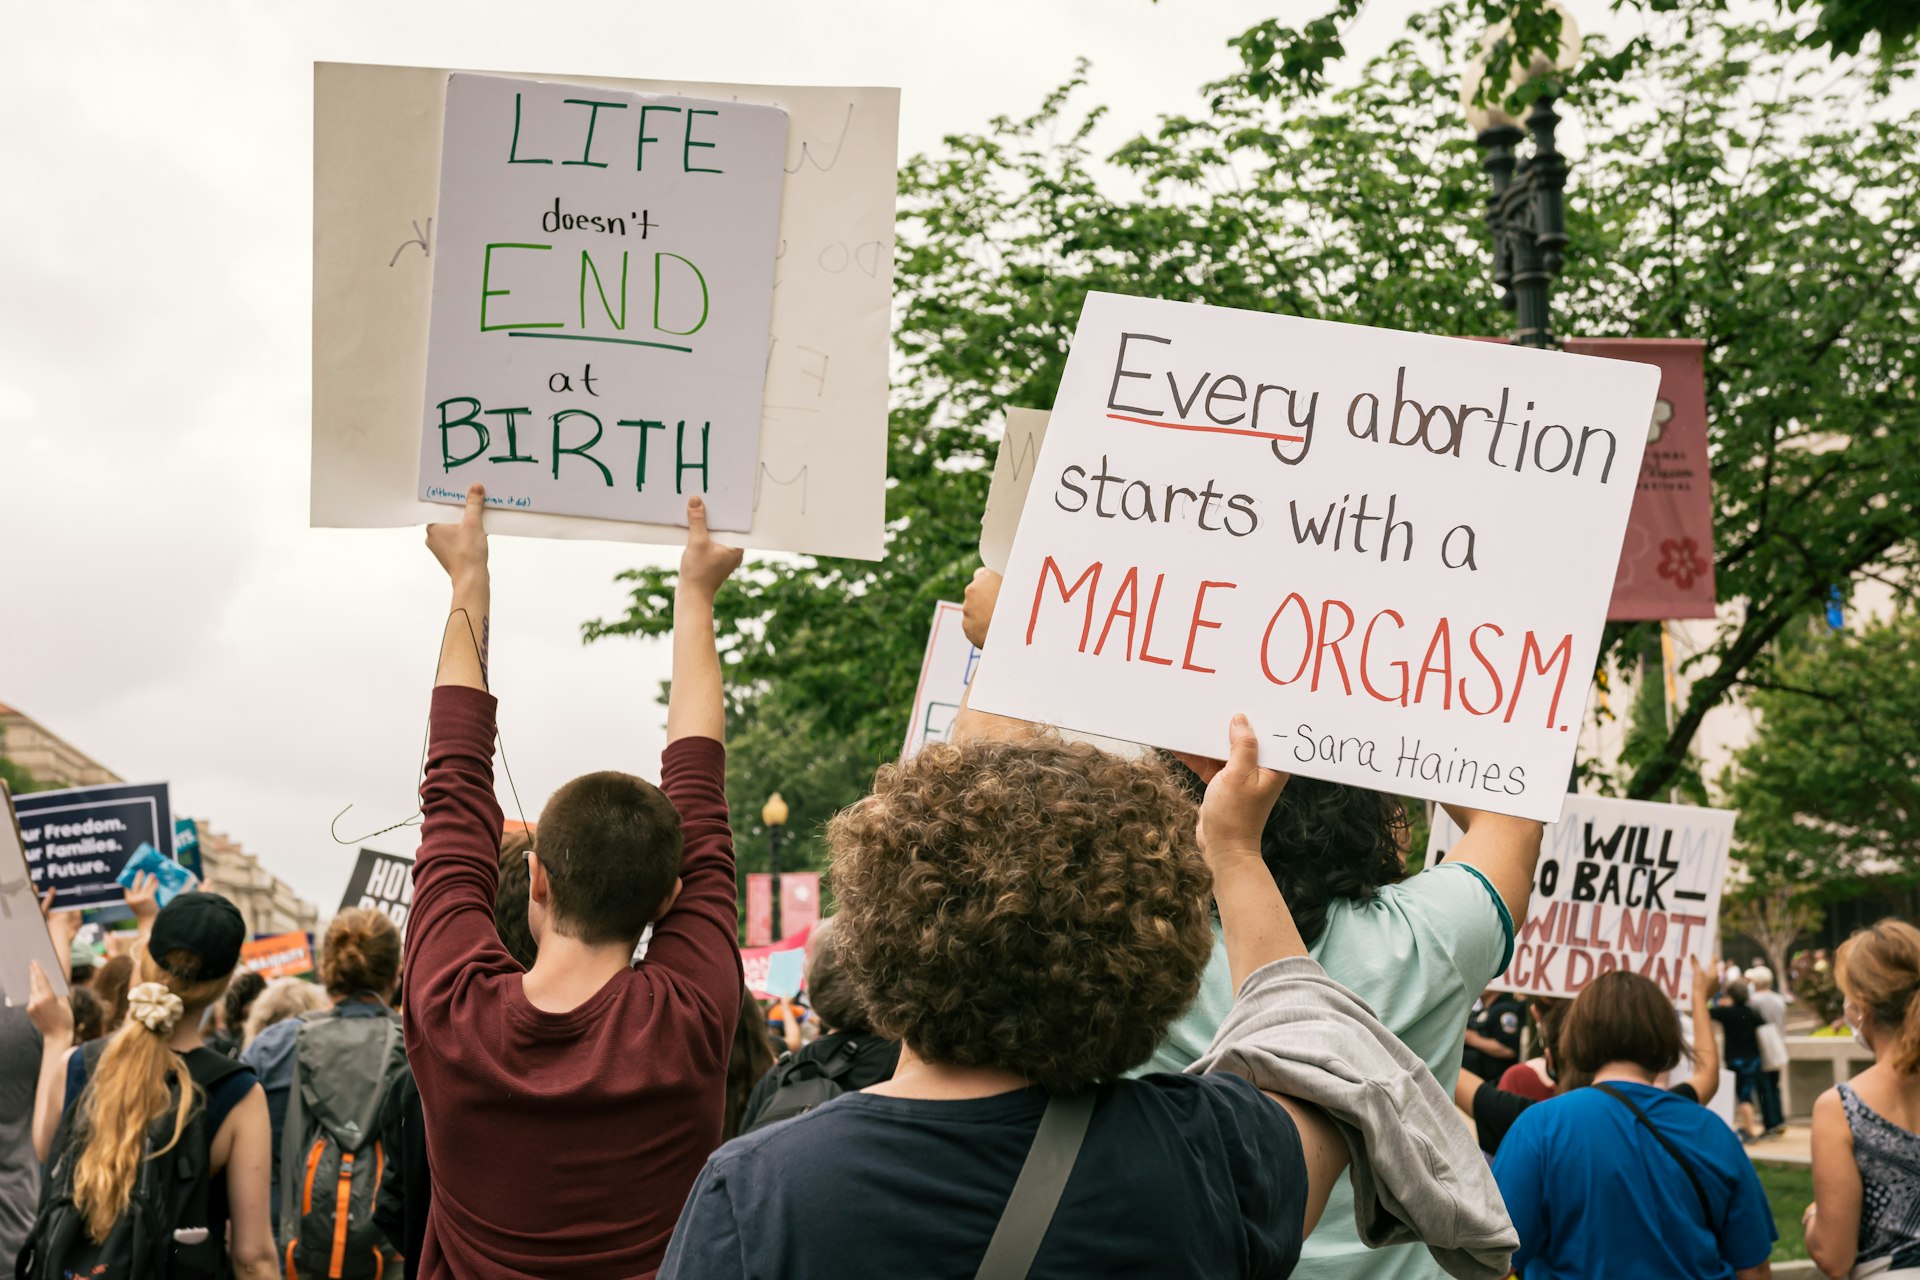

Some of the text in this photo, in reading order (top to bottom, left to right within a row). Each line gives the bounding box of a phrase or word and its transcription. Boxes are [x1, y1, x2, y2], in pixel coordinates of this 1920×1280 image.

[507, 91, 724, 174] LIFE
[542, 197, 659, 239] doesn't
[480, 243, 709, 333] END
[549, 364, 600, 397] at
[1107, 332, 1319, 465] Every
[1347, 366, 1616, 484] abortion
[436, 396, 710, 494] BIRTH
[1055, 457, 1478, 571] starts with a
[1026, 555, 1573, 732] MALE ORGASM.
[1396, 736, 1526, 795] Haines
[20, 818, 127, 843] ur Freedom.
[46, 837, 122, 859] Families.
[1584, 822, 1678, 869] WILL
[47, 857, 110, 879] Future.
[1530, 859, 1559, 898] O
[1521, 901, 1706, 960] WILL NOT
[1500, 944, 1559, 991] CK
